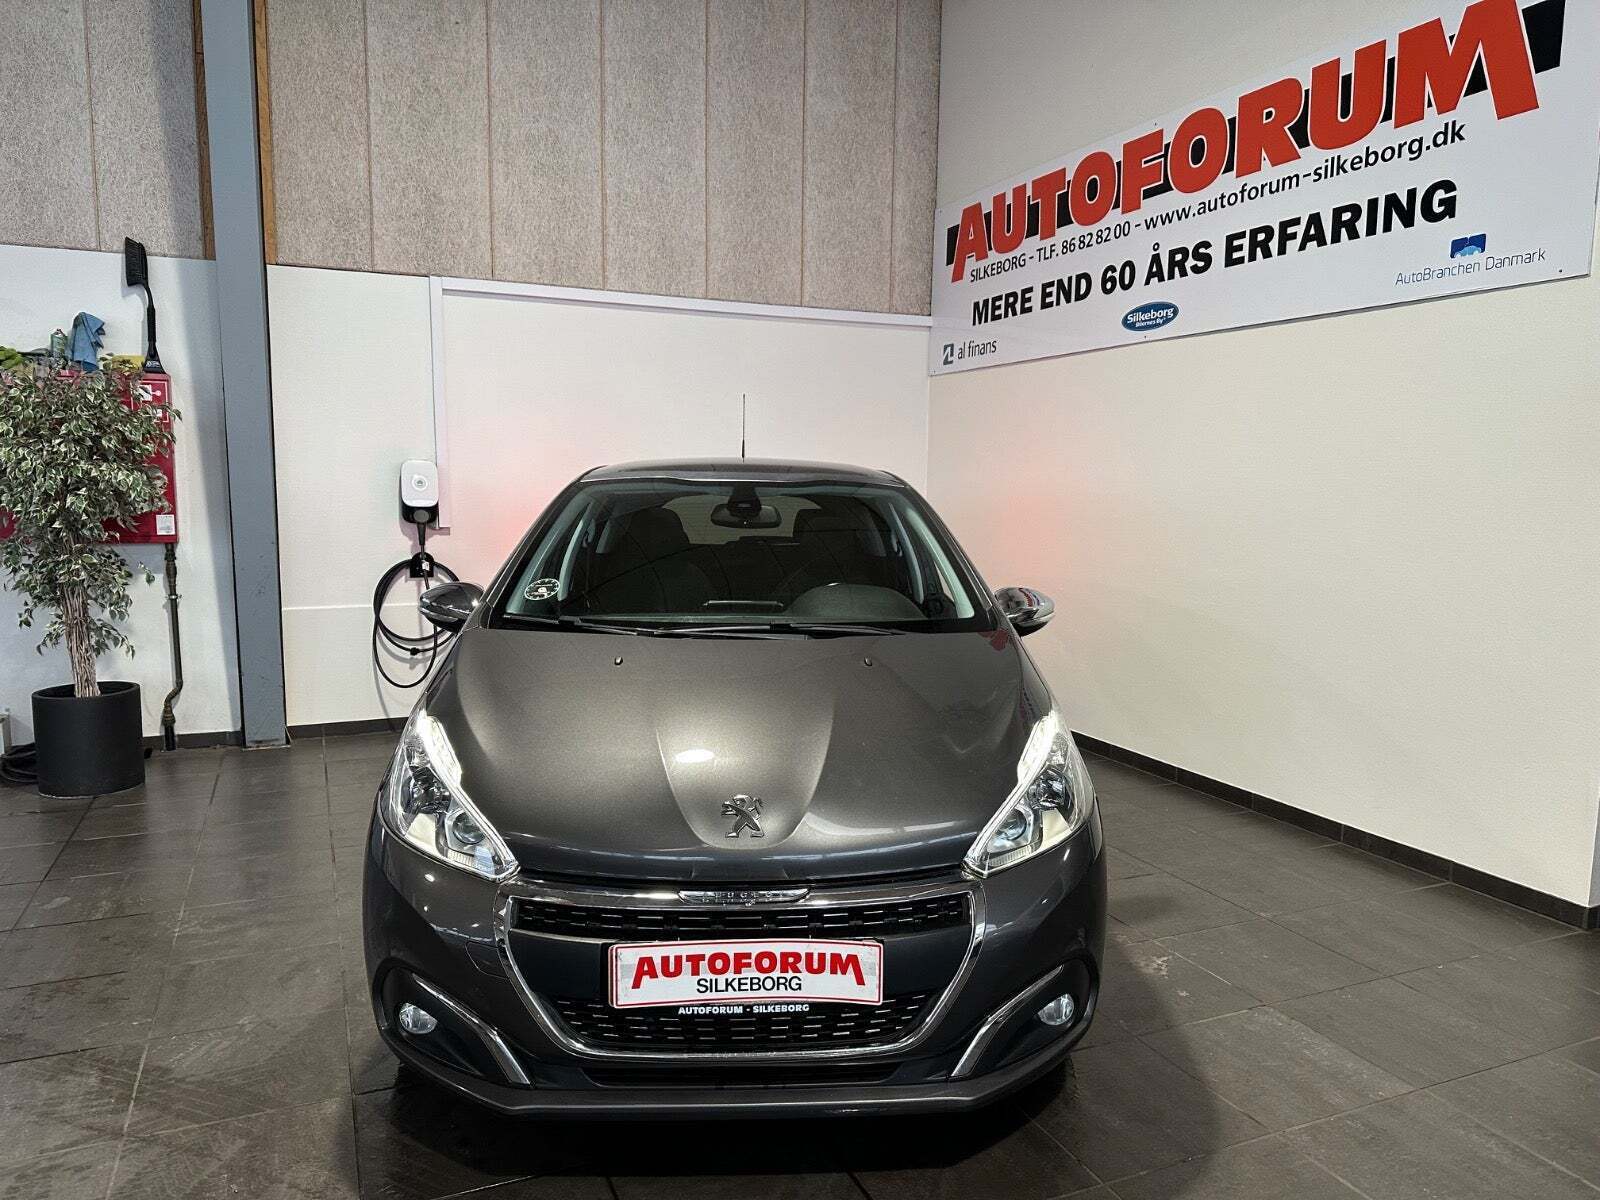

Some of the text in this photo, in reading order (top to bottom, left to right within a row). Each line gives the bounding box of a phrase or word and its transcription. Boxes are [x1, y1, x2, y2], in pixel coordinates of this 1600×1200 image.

[952, 0, 1539, 282] AUTOFORUM
[970, 253, 1026, 283] SILKEBORG
[1037, 244, 1059, 263] TLF.
[1144, 120, 1466, 230] www.autoforum-silkeborg.dk
[972, 179, 1457, 326] MERE END 60 ÅRS ERFARING
[1395, 248, 1547, 286] AutoBranchen Danmark
[1127, 307, 1174, 324] Silkeborg
[958, 340, 997, 360] al finans
[631, 950, 865, 989] AUTOFORUM
[696, 975, 802, 994] SILKEBORG
[678, 1006, 743, 1015] AUTOFORUM
[753, 1004, 810, 1014] SILKEBORG
